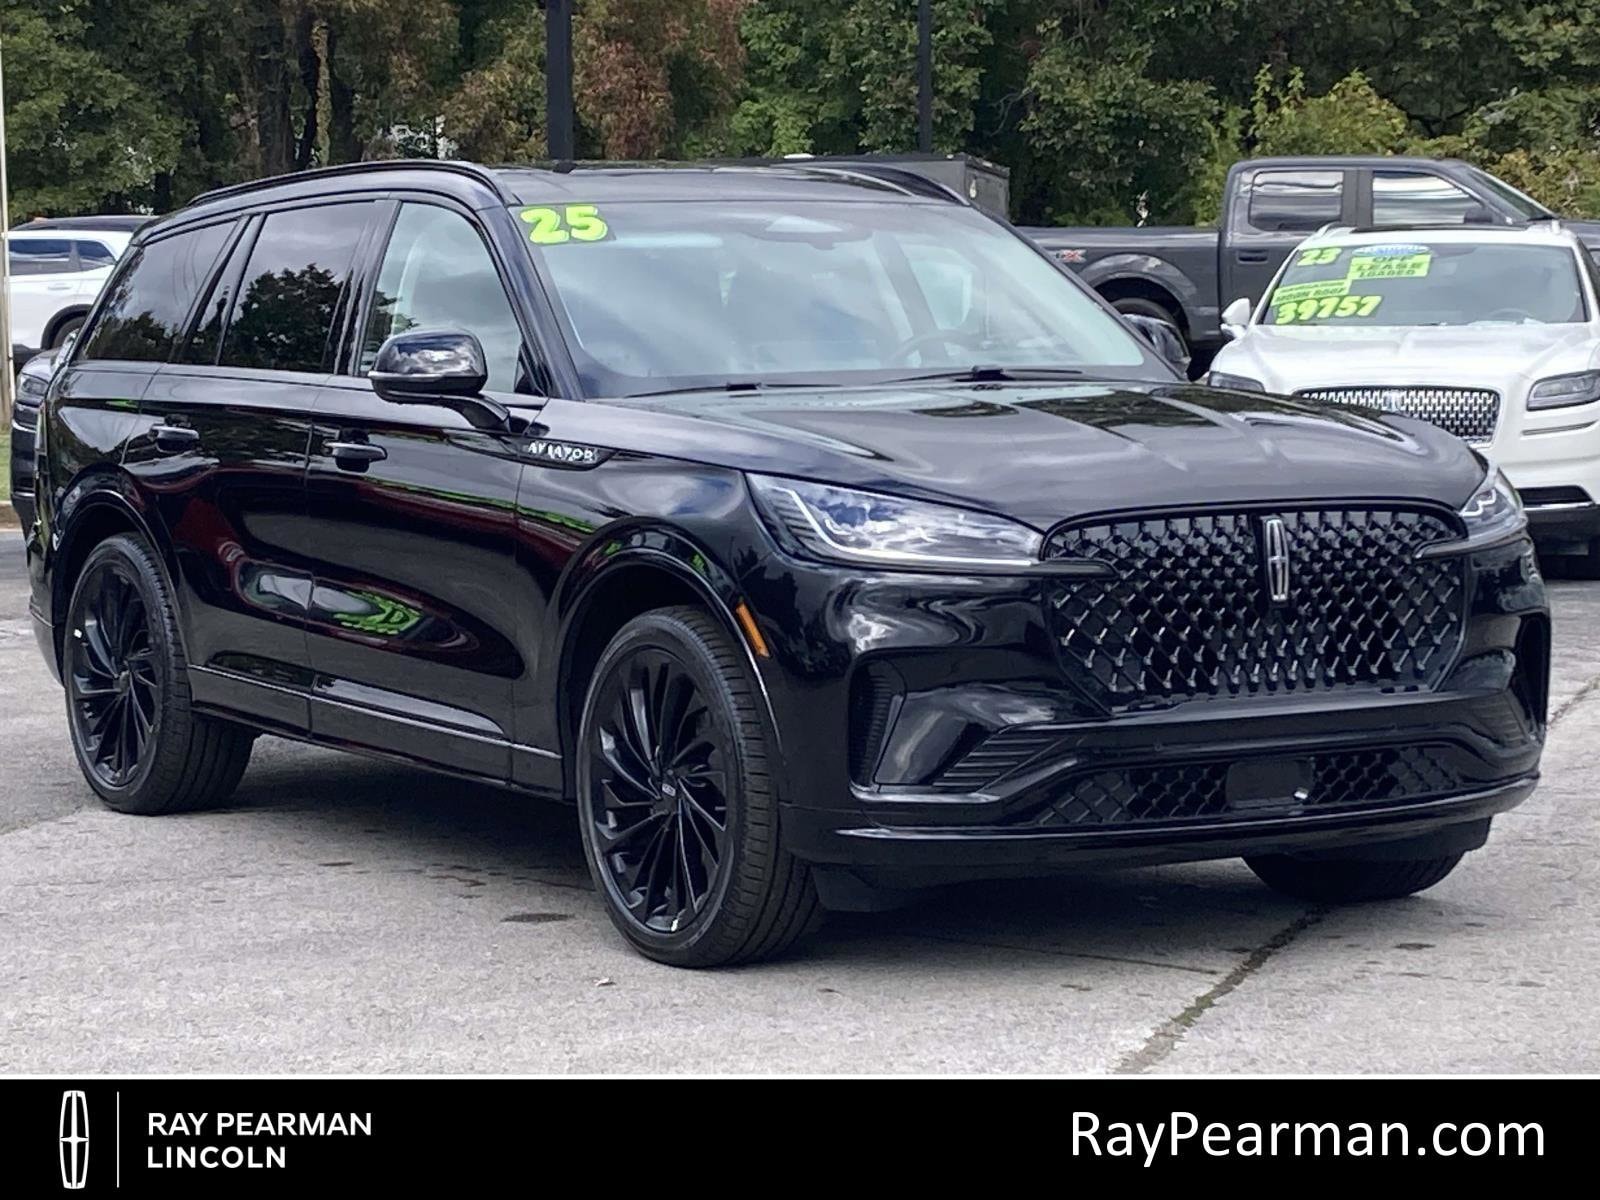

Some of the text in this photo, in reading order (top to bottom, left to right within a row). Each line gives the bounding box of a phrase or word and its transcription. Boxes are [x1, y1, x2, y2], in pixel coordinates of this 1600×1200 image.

[520, 206, 608, 243] 25
[1297, 248, 1342, 266] 23
[1356, 262, 1424, 272] LEASE
[1276, 296, 1382, 325] 39757
[528, 442, 598, 463] AVIATOR
